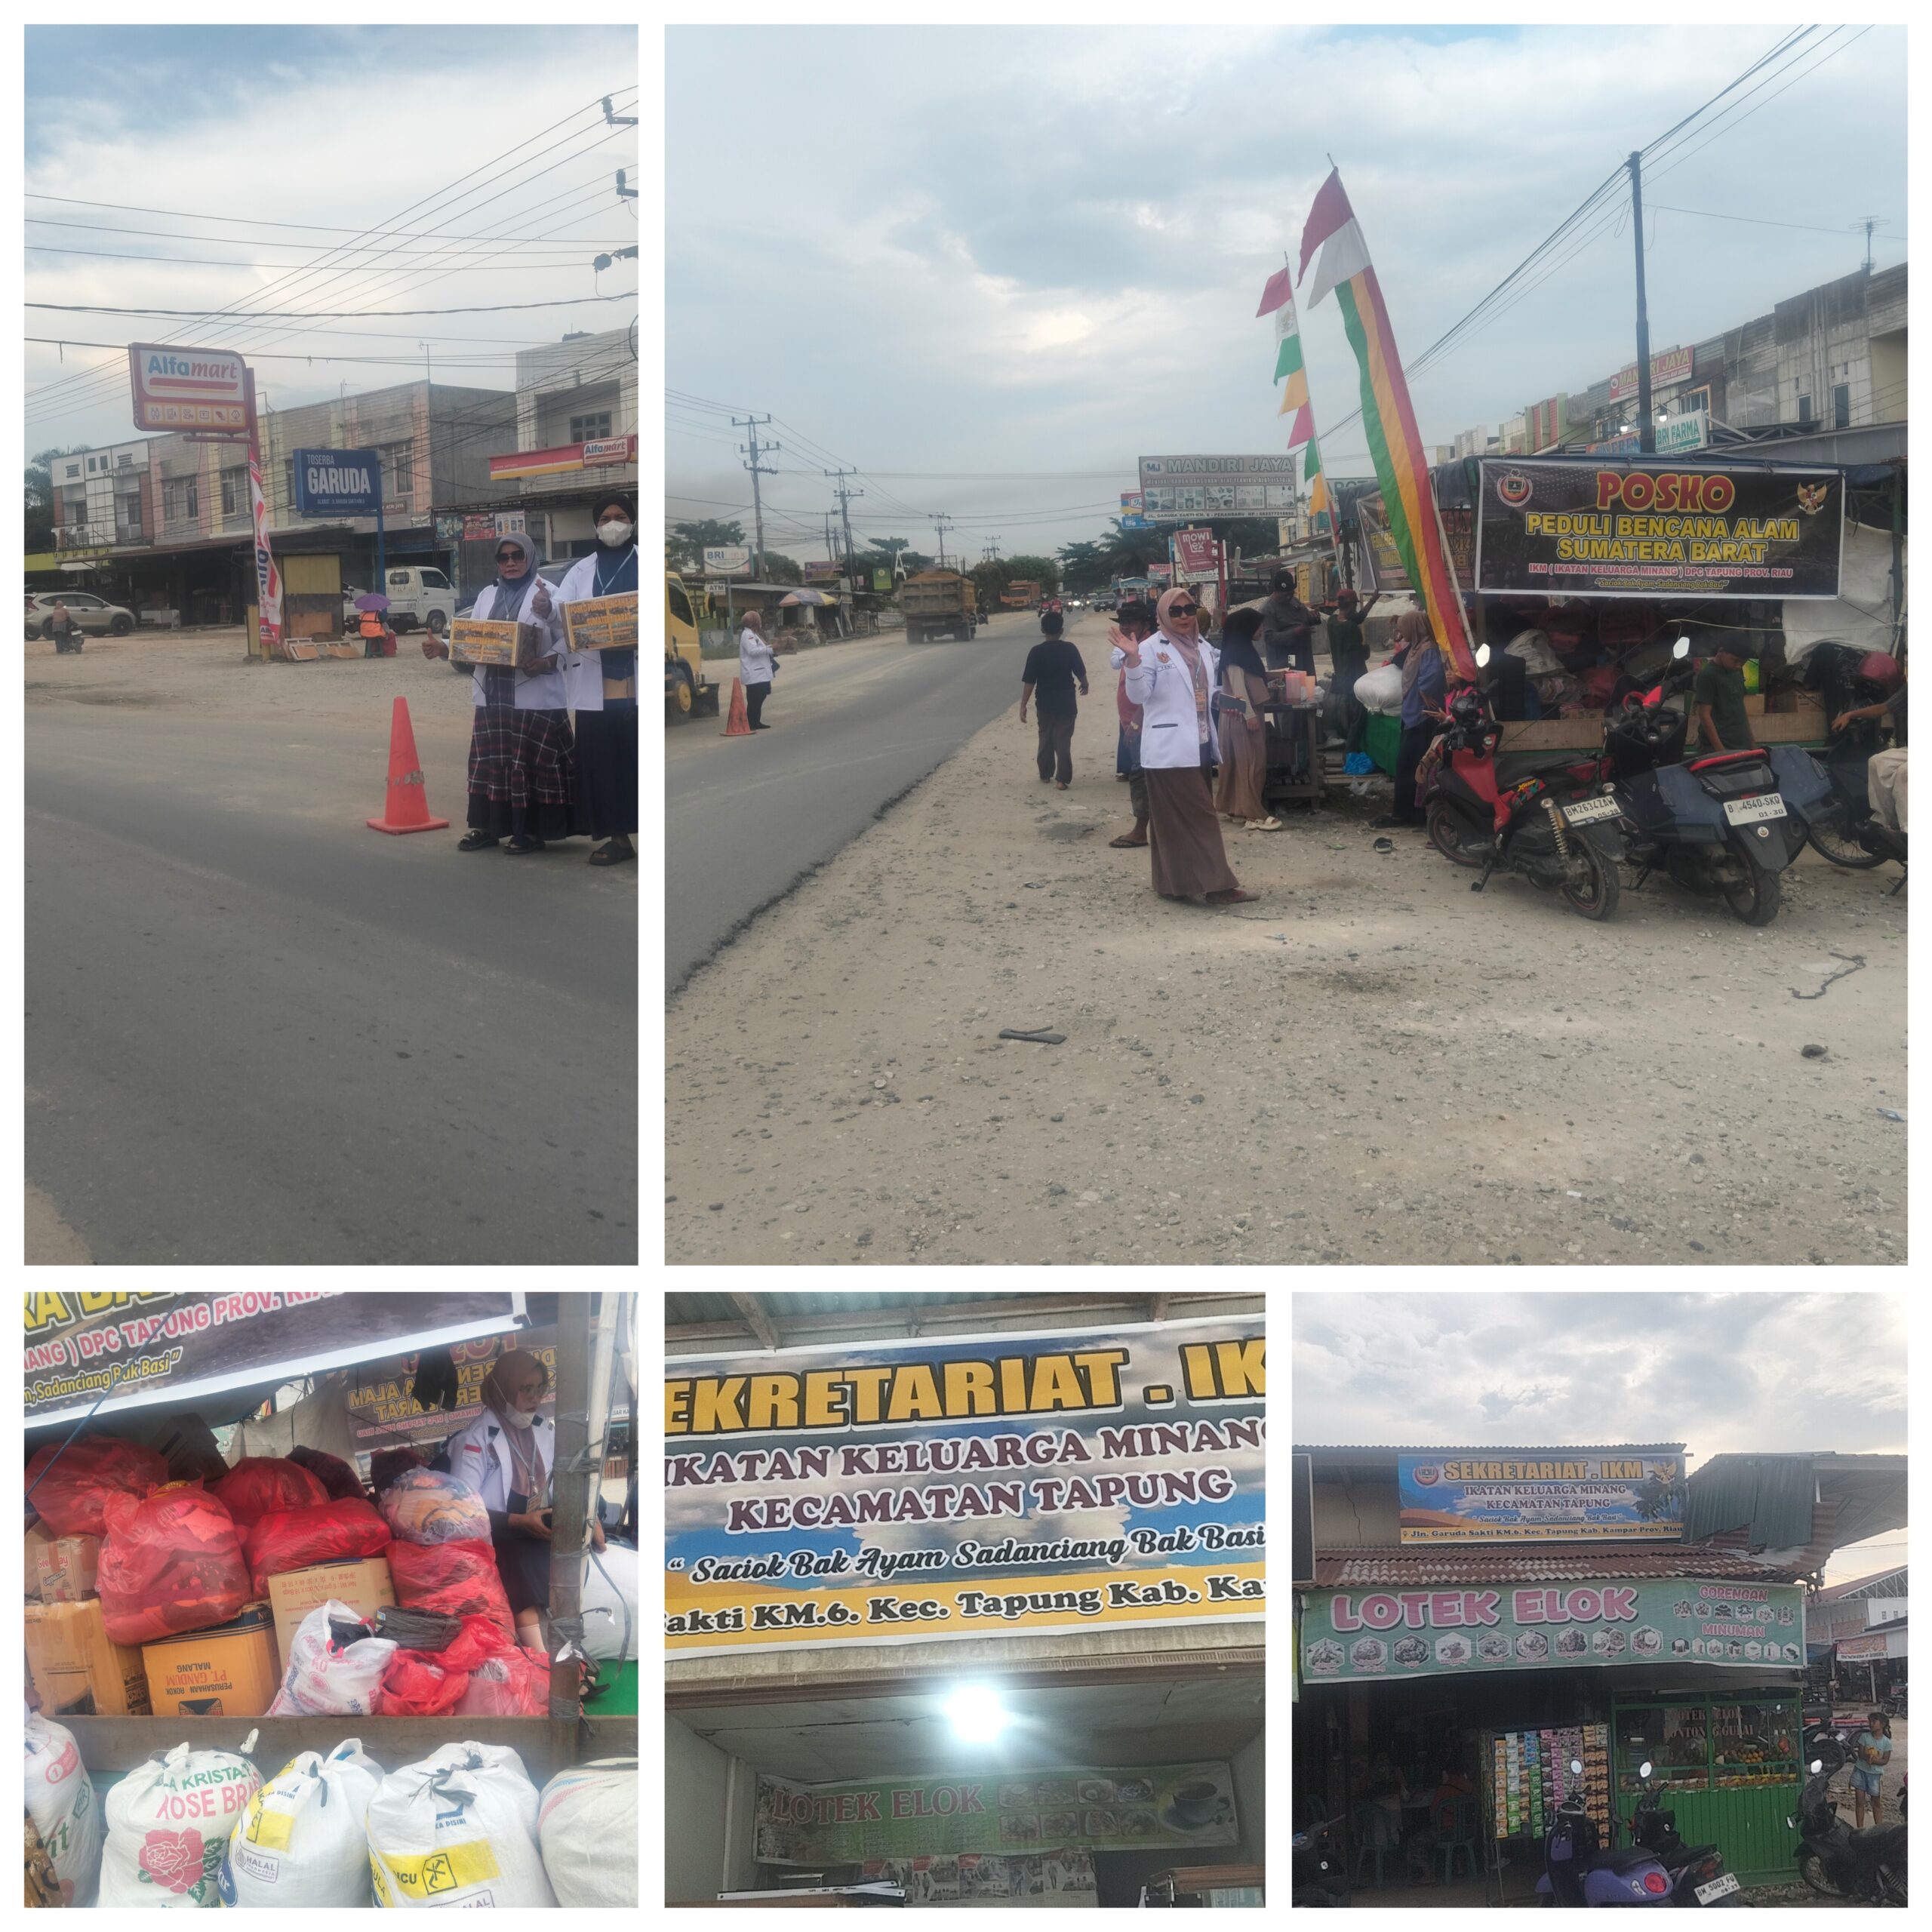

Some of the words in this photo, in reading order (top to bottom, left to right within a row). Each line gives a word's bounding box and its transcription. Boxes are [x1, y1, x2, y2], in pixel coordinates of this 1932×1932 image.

[148, 355, 238, 379] Alfamart
[1619, 359, 1660, 387] MANRI
[1663, 349, 1690, 371] JAYA
[1672, 419, 1700, 440] FARMA
[585, 441, 626, 455] Alfamart
[306, 454, 334, 465] TOSERBA
[1167, 458, 1244, 473] MANDIRI
[1249, 457, 1293, 472] JAYA
[307, 467, 371, 494] GARUDA
[1596, 470, 1736, 514] POSKO
[1525, 512, 1612, 537] PEDULI
[1616, 514, 1730, 540] BENCANA
[1733, 518, 1799, 541] ALAM
[706, 551, 724, 559] BRI
[1556, 537, 1686, 562] SUMATERA
[1690, 540, 1768, 564] BARAT
[1528, 563, 1547, 574] IKM
[1554, 564, 1589, 574] IKATAN
[1590, 565, 1638, 575] KELUARGA
[1641, 565, 1678, 577] MINANG
[1685, 567, 1703, 577] DPC
[1705, 568, 1742, 577] TAPUNG
[1743, 568, 1770, 577] PROV.
[1771, 568, 1793, 578] RIAU
[1727, 804, 1734, 813] B
[78, 1328, 122, 1359] DPC
[122, 1304, 211, 1346] TAPUNG
[214, 1292, 280, 1327] PROV.
[37, 1368, 111, 1400] Sadanciang
[111, 1361, 141, 1388] Bak
[140, 1355, 171, 1380] Basi
[839, 1429, 1094, 1477] KELUARGA
[1101, 1417, 1266, 1460] MINAN
[1443, 1460, 1588, 1481] SEKRETARIAT
[1601, 1460, 1644, 1480] IKM
[1465, 1485, 1513, 1497] IKATAN
[1513, 1484, 1578, 1497] KELUARGA
[1580, 1484, 1626, 1495] MINANG
[725, 1478, 1026, 1534] KECAMATAN
[1031, 1467, 1236, 1515] TAPUNG
[1486, 1498, 1562, 1510] KECAMATAN
[1563, 1498, 1611, 1509] TAPUNG
[690, 1551, 786, 1584] Saciok
[786, 1548, 852, 1577] Bak
[856, 1546, 947, 1580] Ayam
[953, 1535, 1129, 1567] Sadanciang
[1129, 1524, 1198, 1555] Bak
[1197, 1523, 1265, 1551] Basi
[867, 1595, 950, 1621] Kec.
[955, 1588, 1103, 1620] Tapung
[1106, 1579, 1202, 1607] Kab.
[1206, 1575, 1266, 1601] Ka
[1700, 1586, 1768, 1602] GORENGAN
[1330, 1589, 1503, 1633] LOTEK
[1510, 1586, 1639, 1626] ELOK
[1702, 1623, 1765, 1638] MINUMAN
[177, 1662, 211, 1673] MALANG
[166, 1672, 208, 1686] GANDUM
[208, 1670, 226, 1684] PT.
[165, 1684, 184, 1696] ROKOK
[189, 1681, 232, 1695] PERUSAHAAN
[276, 1790, 296, 1800] DISINI
[771, 1788, 883, 1826] LOTEK
[891, 1783, 986, 1821] ELOK
[445, 1818, 466, 1827] DISINI
[246, 1855, 275, 1872] HALAL
